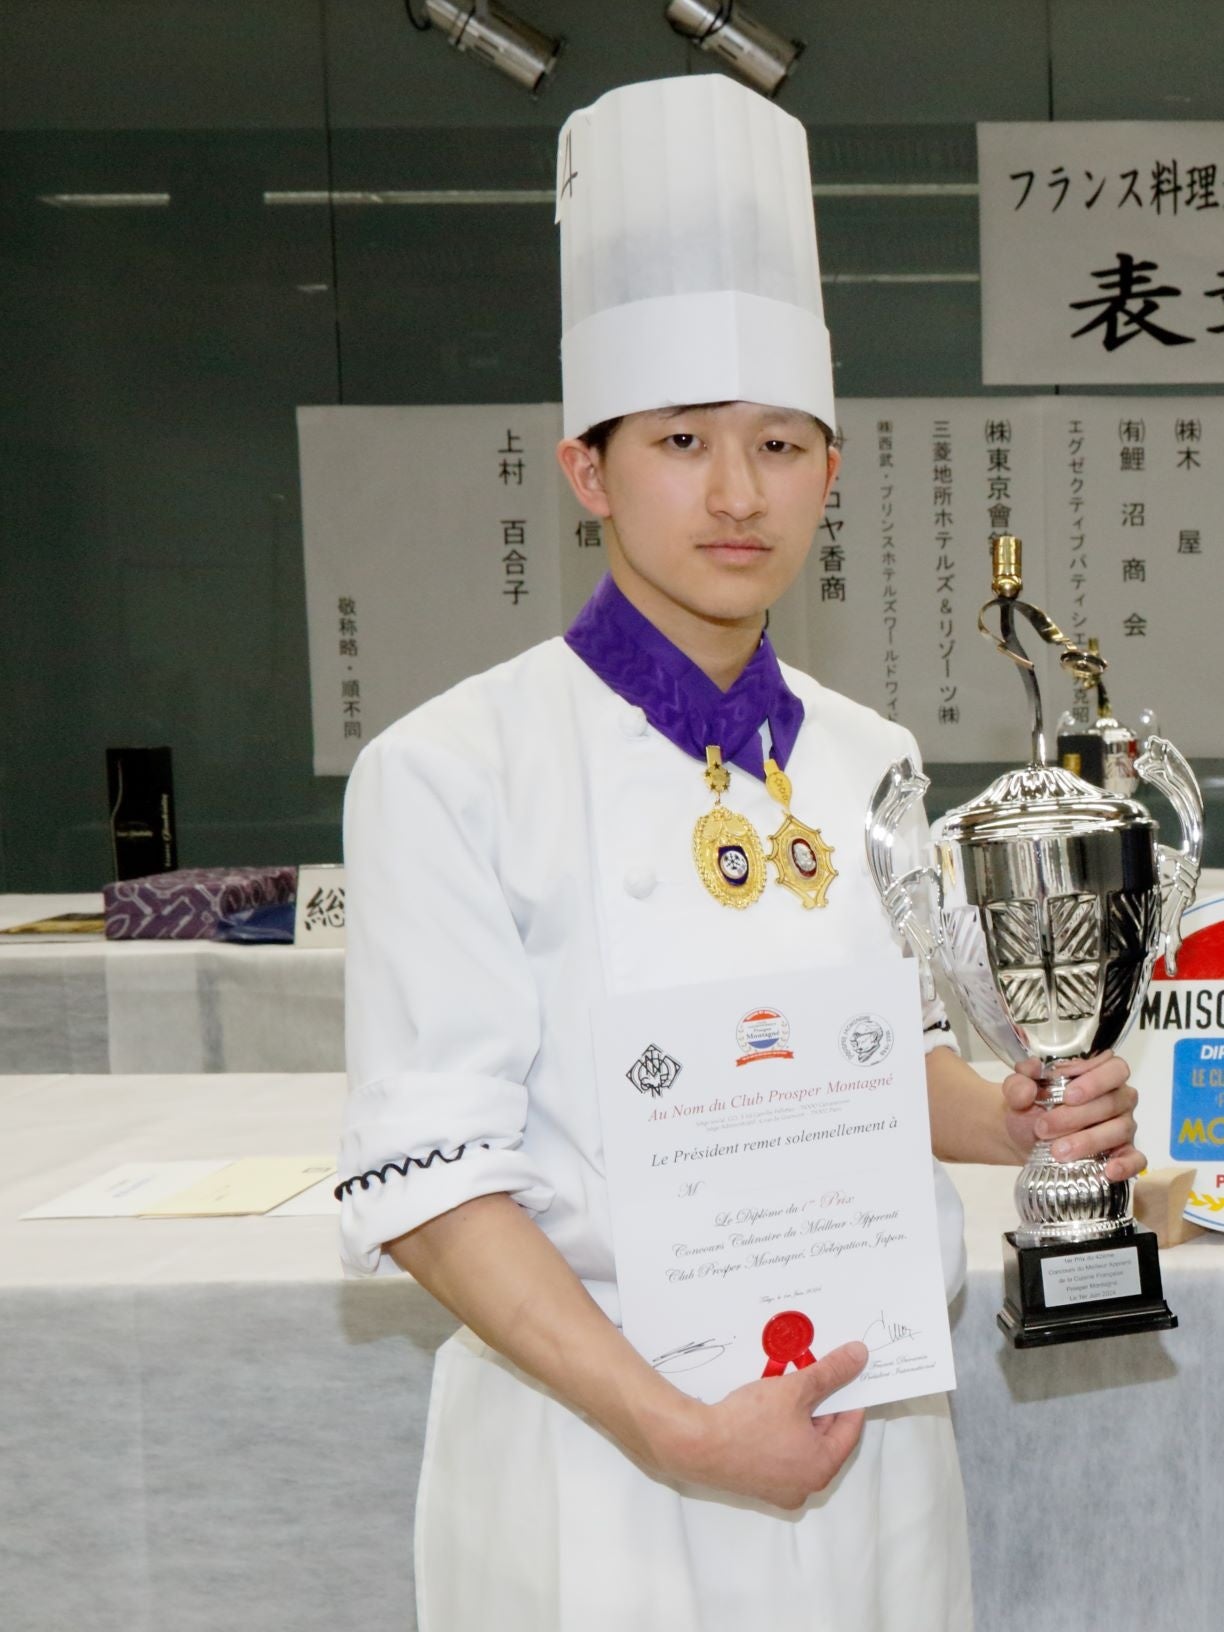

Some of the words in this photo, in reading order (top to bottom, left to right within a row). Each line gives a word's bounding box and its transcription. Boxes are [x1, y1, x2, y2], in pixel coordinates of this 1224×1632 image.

[497, 428, 526, 486] 上村
[500, 519, 530, 605] 百合子
[337, 597, 362, 740] 敬称略・順不同
[648, 1108, 668, 1122] Au
[673, 1103, 704, 1118] Nom
[708, 1098, 726, 1112] du
[731, 1092, 763, 1109] Club
[768, 1086, 821, 1102] Prosper
[827, 1073, 893, 1093] Montagné
[1192, 1069, 1205, 1087] LE
[651, 1153, 668, 1167] Le
[674, 1143, 739, 1162] Président
[743, 1135, 781, 1152] remet
[785, 1119, 886, 1146] solennellement
[889, 1115, 898, 1129] à
